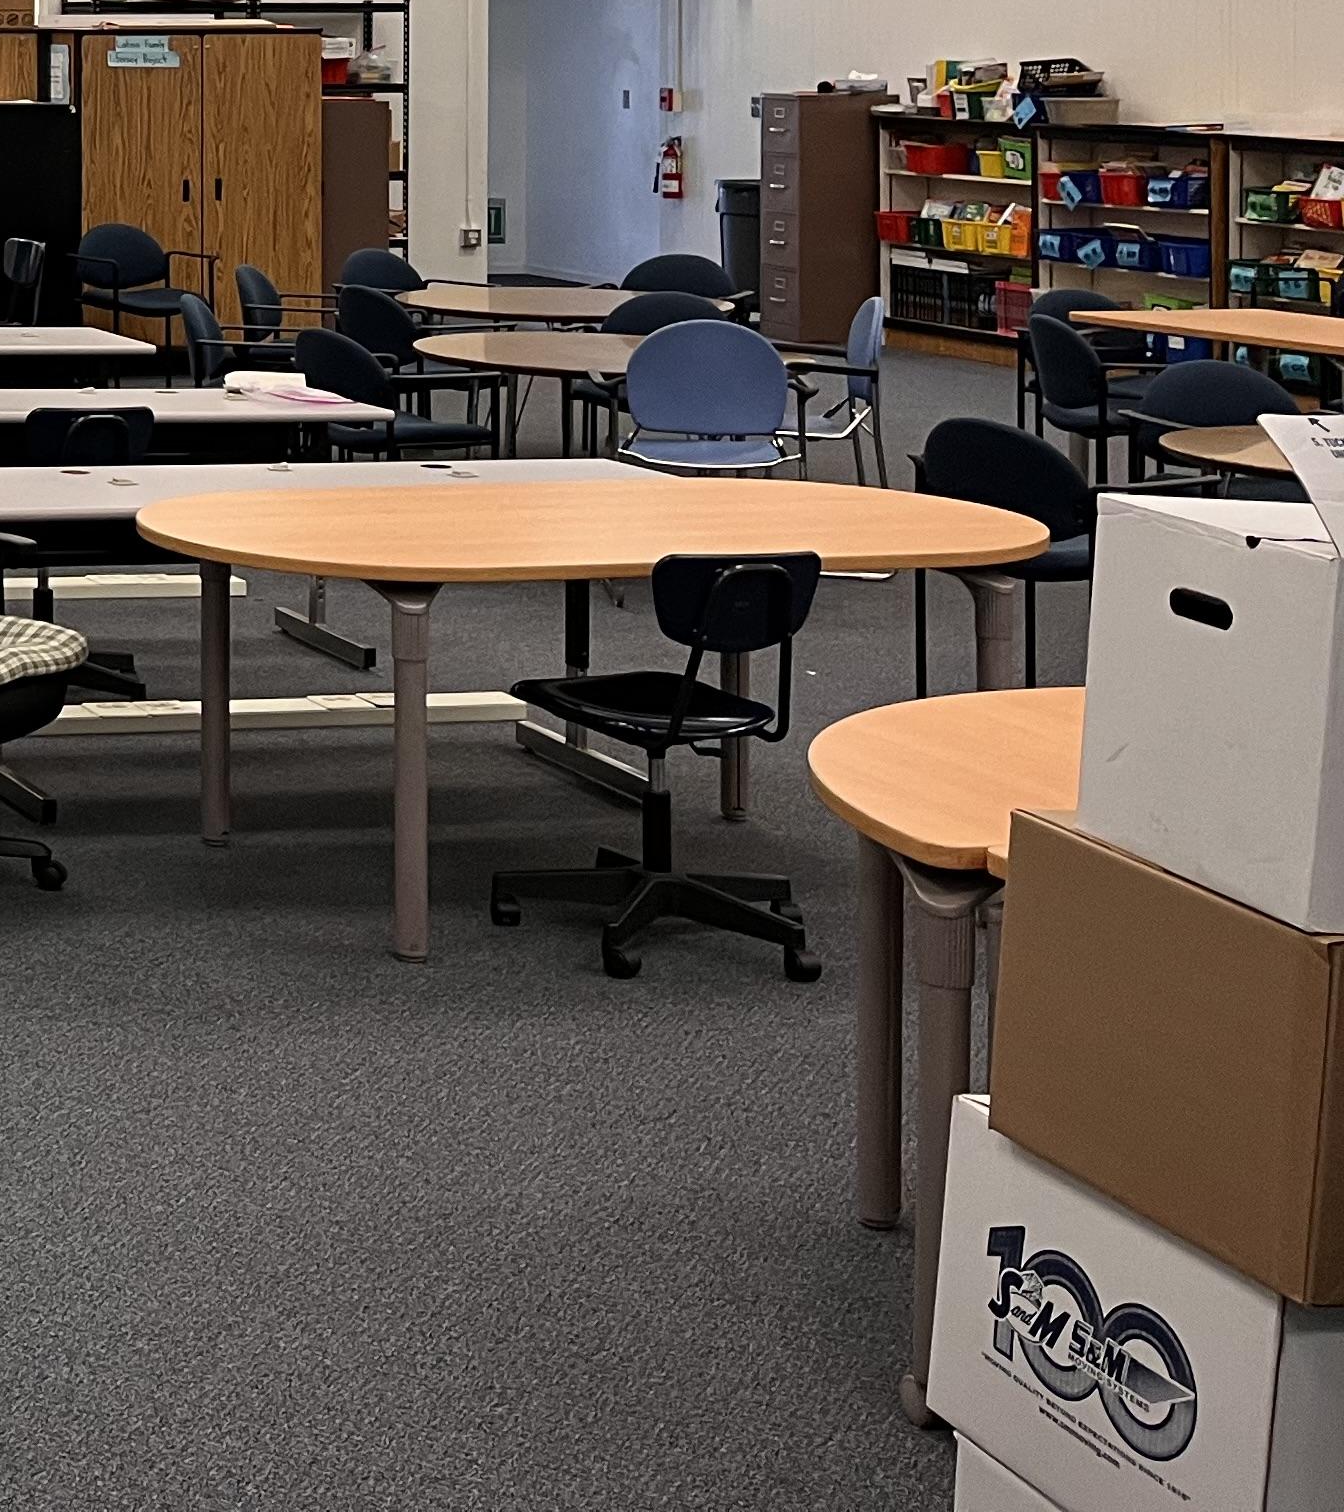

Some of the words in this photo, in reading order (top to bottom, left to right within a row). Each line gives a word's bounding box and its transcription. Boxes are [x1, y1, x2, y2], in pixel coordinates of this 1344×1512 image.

[1009, 1304, 1037, 1327] and
[1027, 1300, 1072, 1350] M
[1068, 1319, 1132, 1386] S&M
[1012, 1374, 1045, 1400] QUALITY
[1077, 1420, 1138, 1467] EXPECTATIONS
[1106, 1377, 1151, 1414] SYSTEMS
